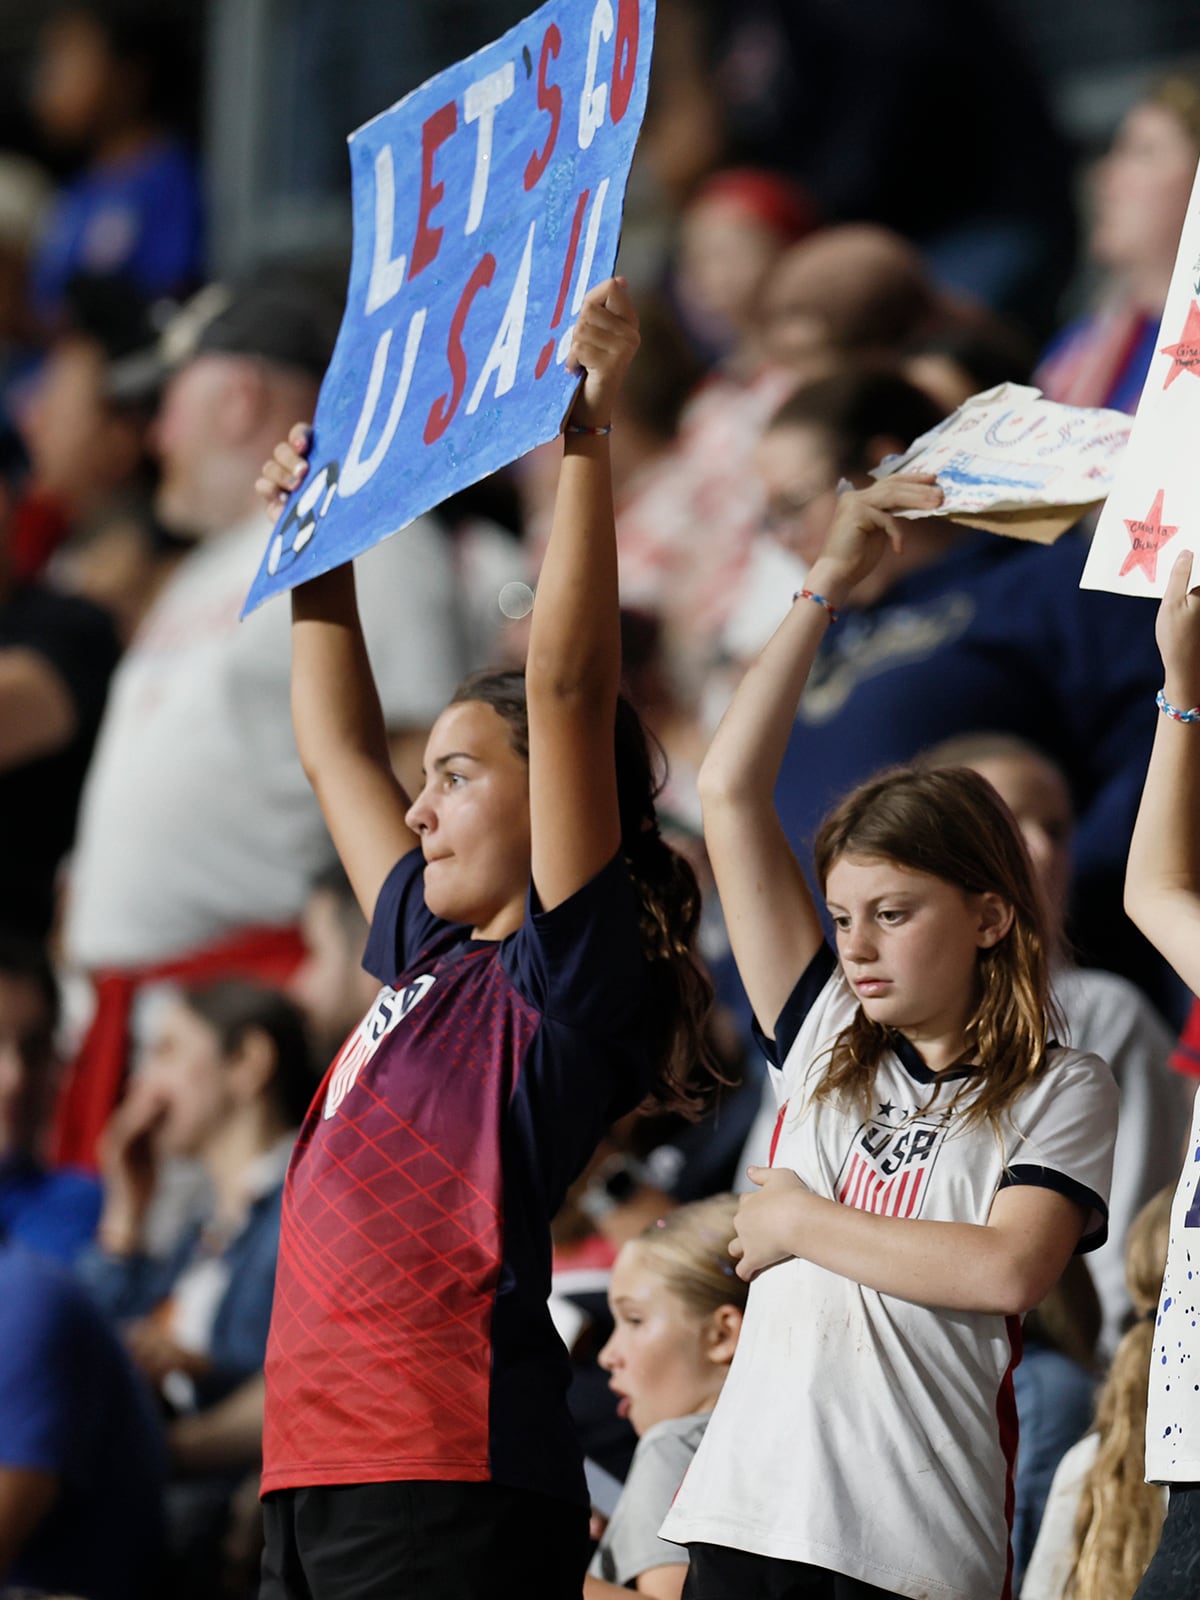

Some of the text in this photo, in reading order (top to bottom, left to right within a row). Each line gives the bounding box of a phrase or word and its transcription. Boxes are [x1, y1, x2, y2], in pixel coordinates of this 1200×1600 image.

[365, 0, 640, 315] LET'S GO
[366, 982, 425, 1042] SA
[860, 1127, 939, 1176] USA
